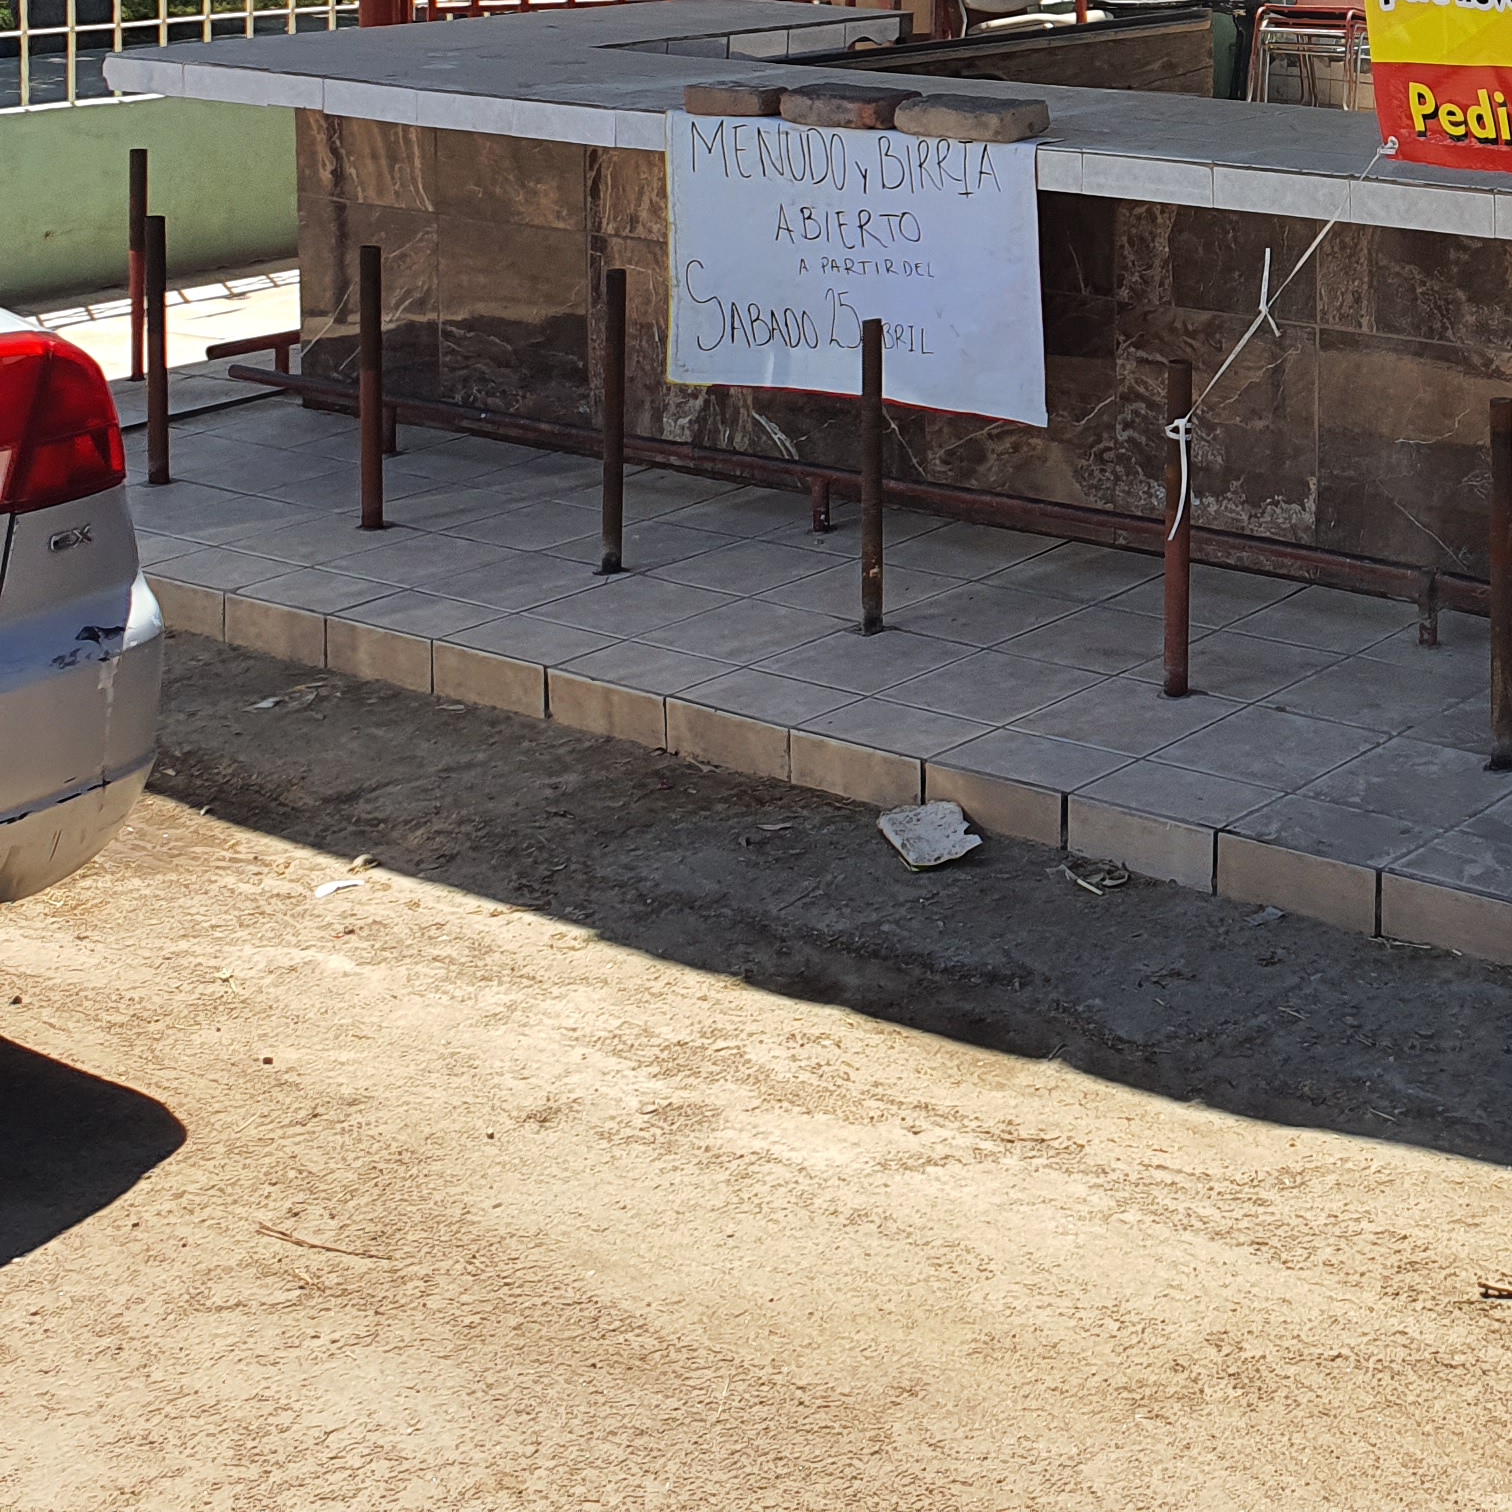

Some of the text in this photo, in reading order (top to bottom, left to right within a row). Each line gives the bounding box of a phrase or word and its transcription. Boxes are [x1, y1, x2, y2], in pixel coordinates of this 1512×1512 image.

[690, 118, 847, 191] MENUDO
[877, 135, 1002, 199] BIRRIA
[774, 202, 922, 250] ABIERTO
[799, 255, 935, 279] A PARTIR DEL
[685, 259, 935, 355] SABADO 25 BRIL
